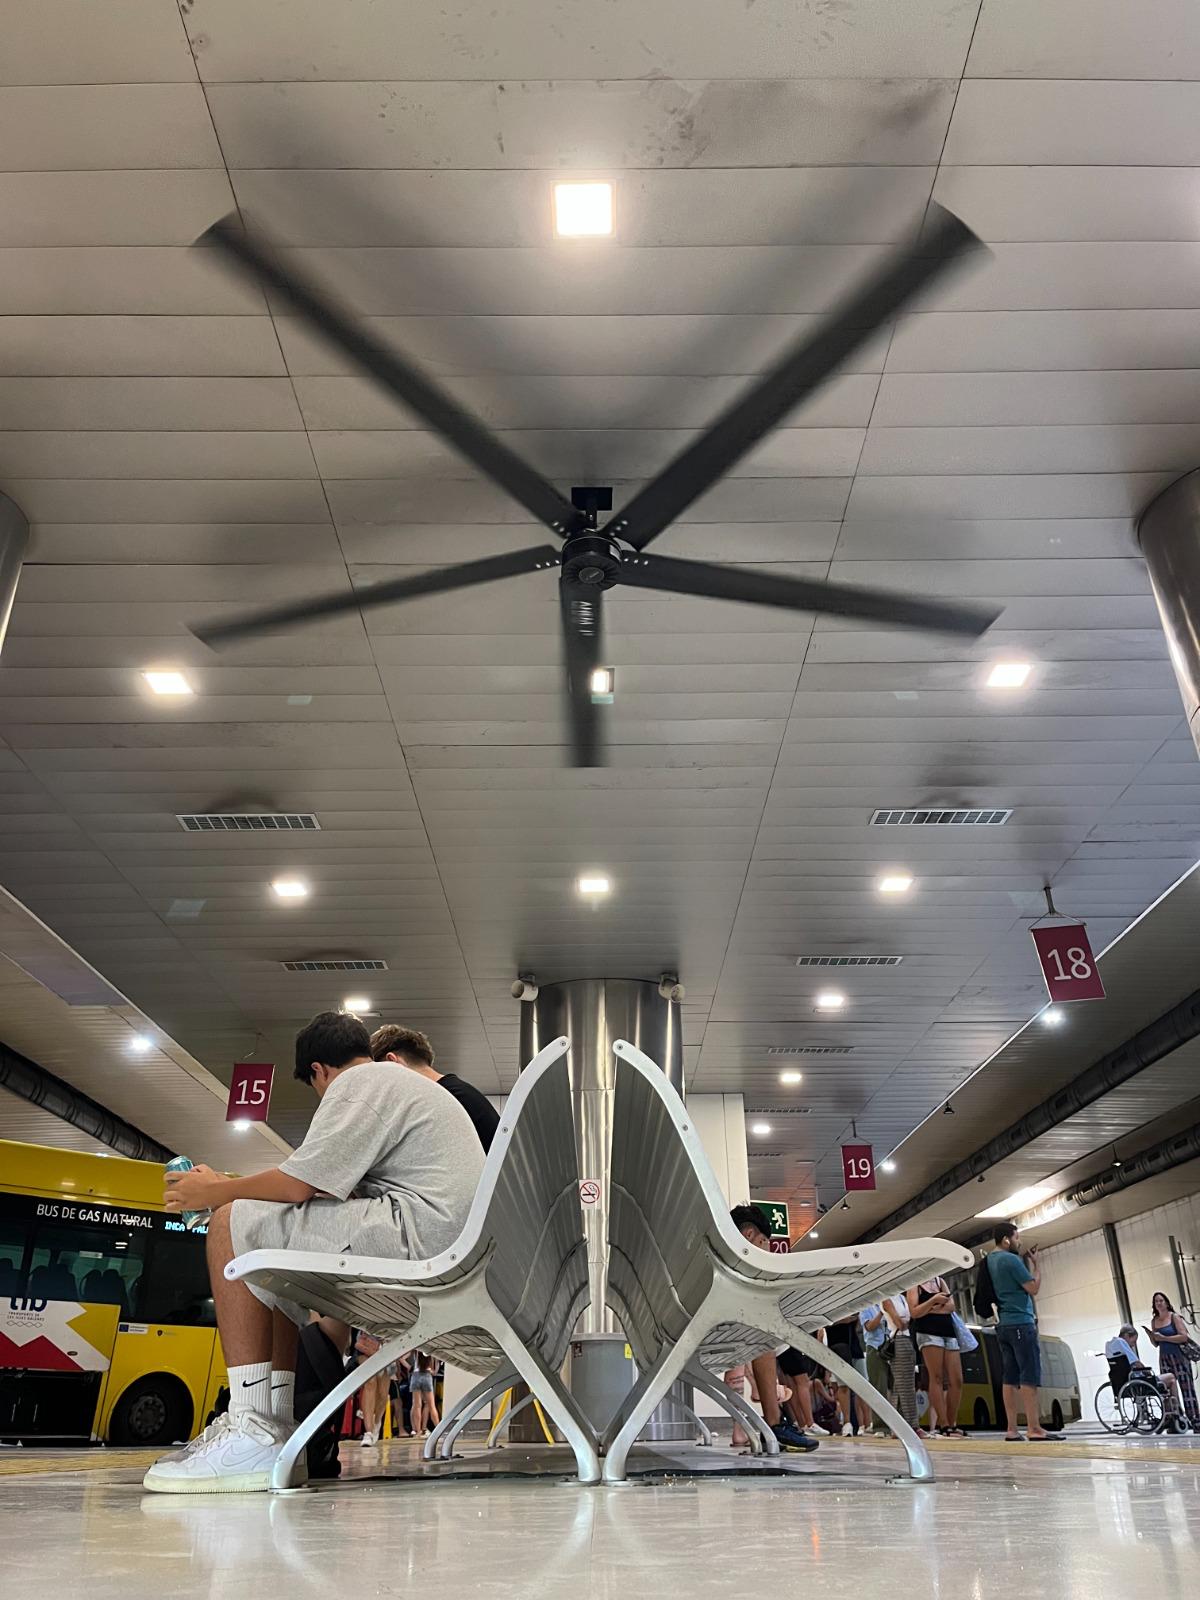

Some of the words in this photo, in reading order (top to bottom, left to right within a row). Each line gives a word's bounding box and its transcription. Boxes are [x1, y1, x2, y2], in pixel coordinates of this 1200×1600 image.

[1047, 947, 1092, 980] 18
[235, 1079, 267, 1105] 15
[847, 1158, 871, 1178] 19
[36, 1203, 59, 1217] BUS
[61, 1206, 77, 1219] DE
[78, 1208, 101, 1222] GAS
[102, 1211, 153, 1229] NATURAL
[164, 1220, 186, 1232] INCA
[772, 1240, 789, 1254] 20
